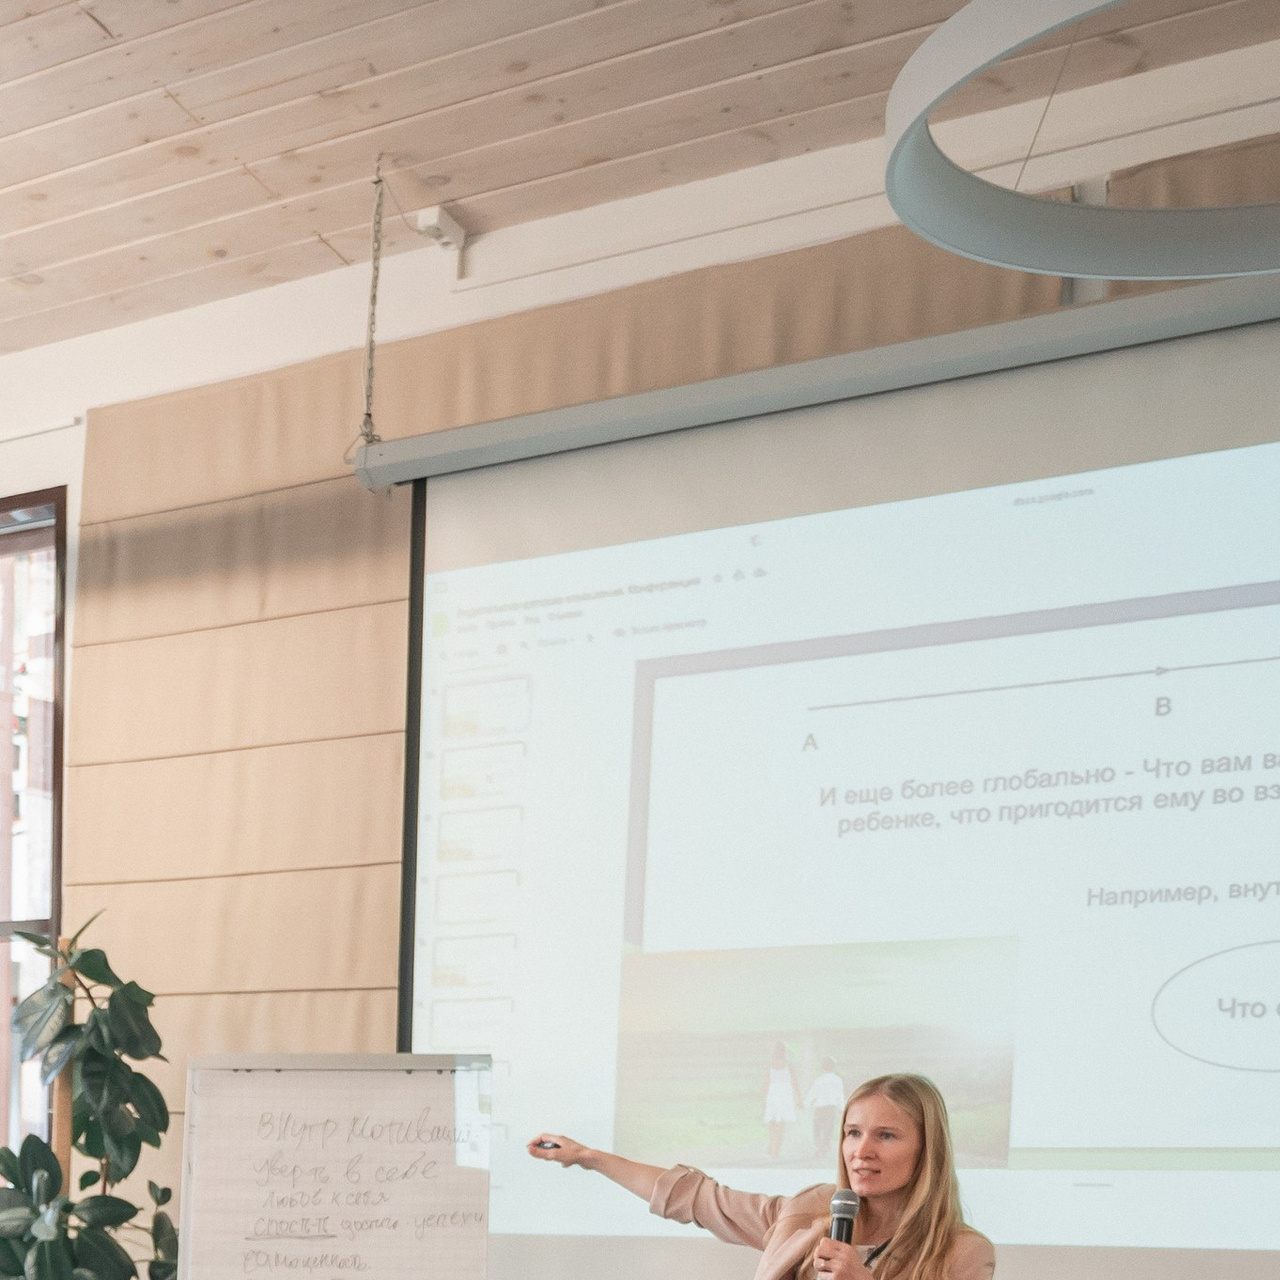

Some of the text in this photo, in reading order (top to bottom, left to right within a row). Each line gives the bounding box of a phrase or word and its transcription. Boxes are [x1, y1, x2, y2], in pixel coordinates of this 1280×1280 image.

[820, 786, 837, 807] И
[844, 786, 893, 805] еще
[901, 778, 974, 800] более
[983, 767, 1116, 793] глобально
[1143, 758, 1192, 779] Что
[1201, 754, 1253, 775] вам
[838, 811, 941, 838] ребенке,
[950, 806, 991, 824] что
[999, 794, 1142, 825] пригодится
[1154, 789, 1205, 812] ему
[1212, 786, 1245, 805] во
[1087, 884, 1219, 909] Например,
[1218, 997, 1267, 1019] Что
